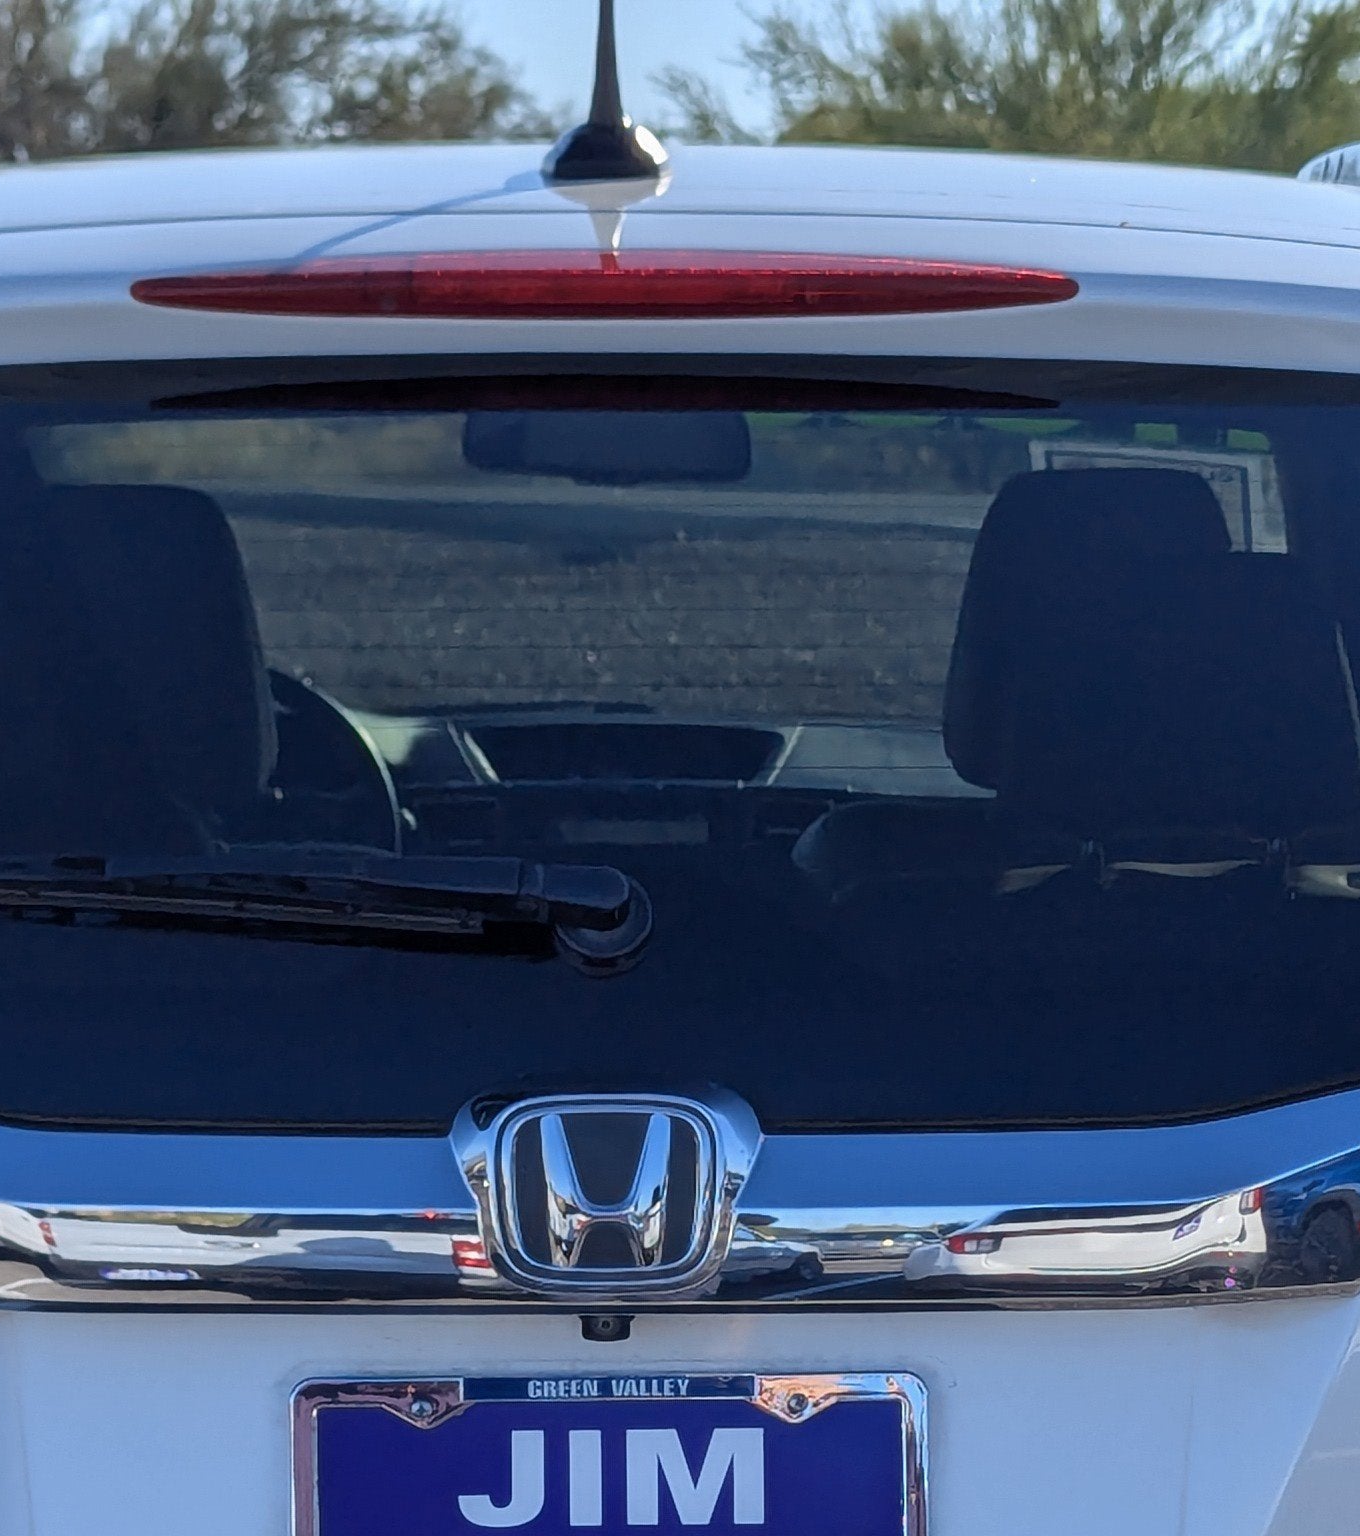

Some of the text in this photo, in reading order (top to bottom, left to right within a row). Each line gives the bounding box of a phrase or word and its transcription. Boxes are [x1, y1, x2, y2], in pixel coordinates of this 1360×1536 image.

[527, 1378, 690, 1399] GREEN VALLEY
[458, 1427, 766, 1528] JIM
